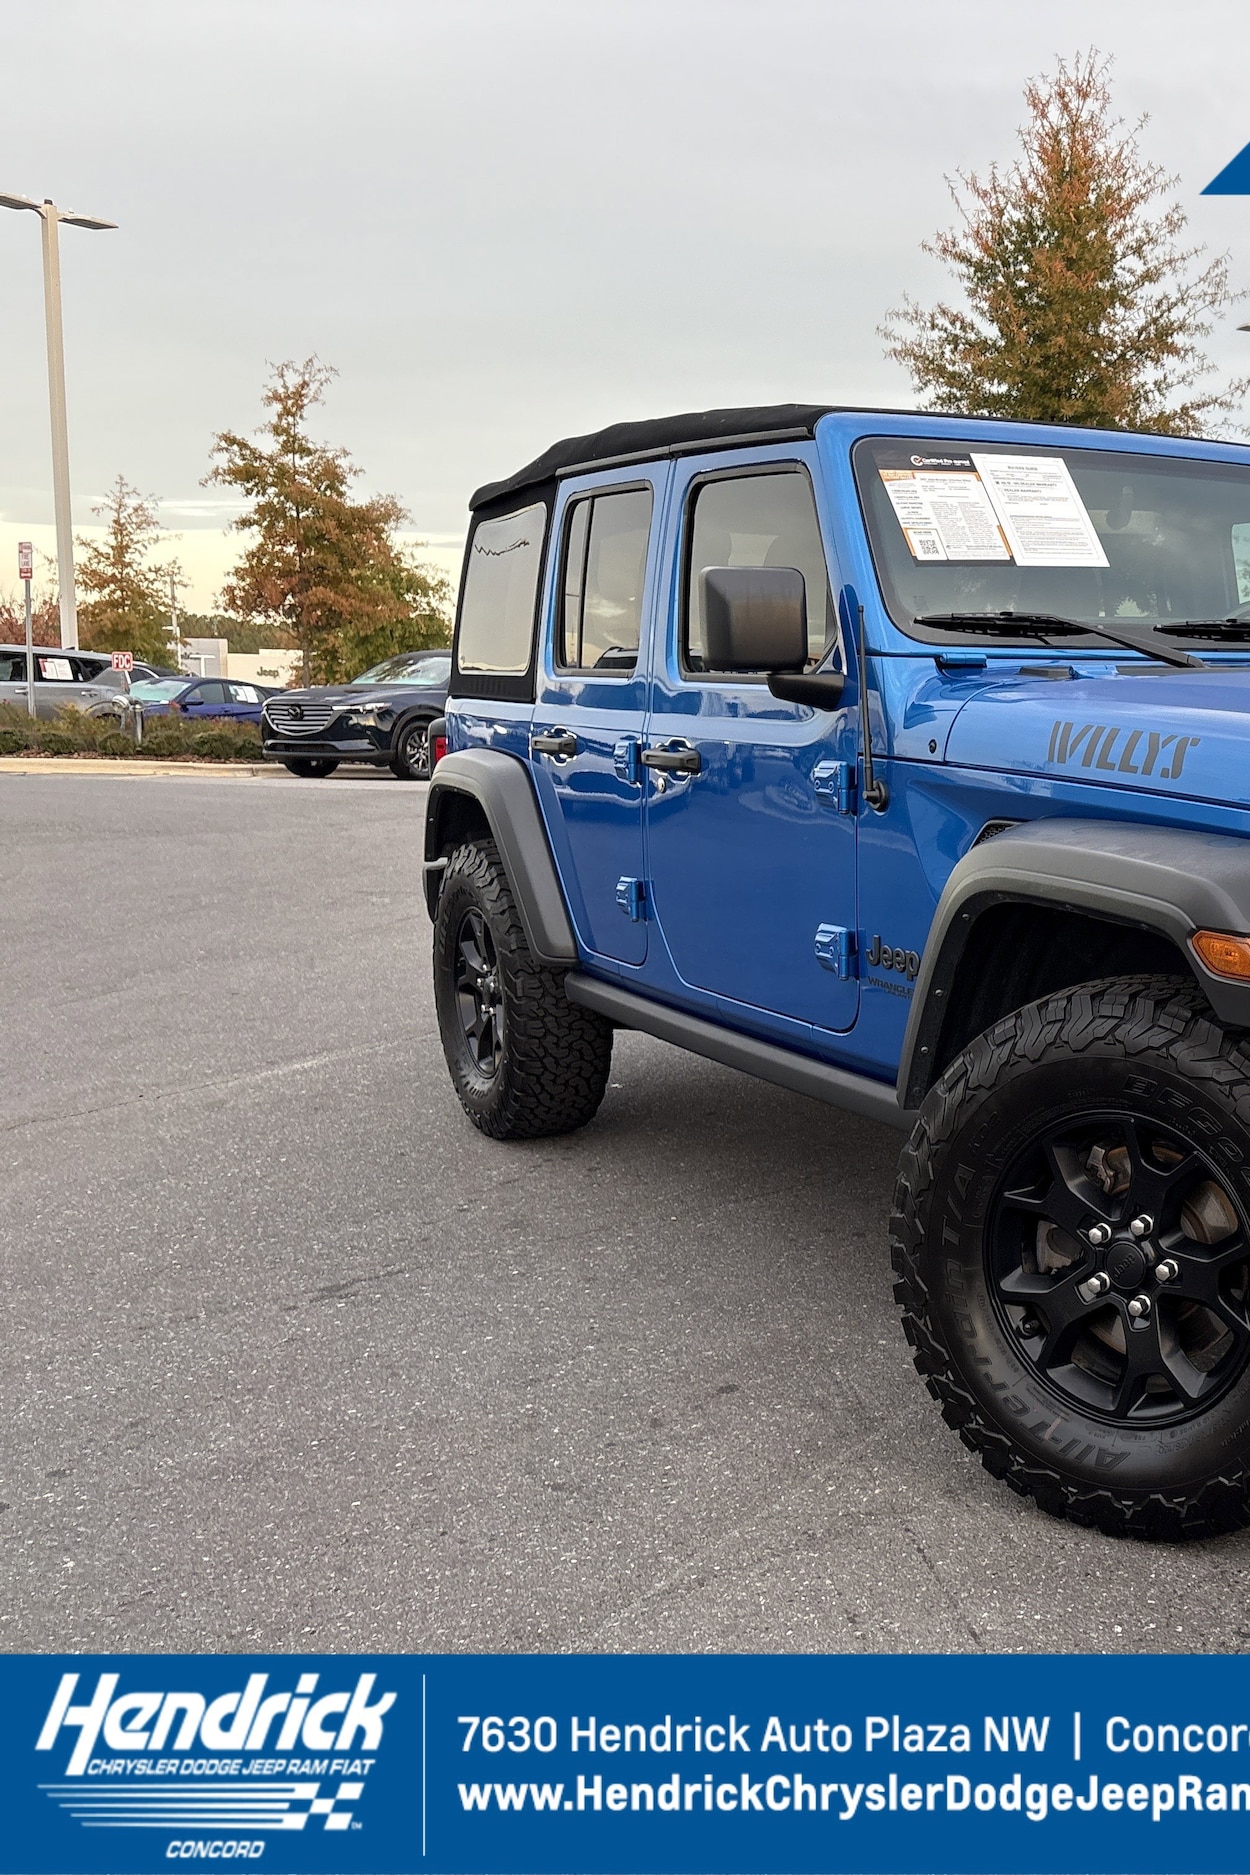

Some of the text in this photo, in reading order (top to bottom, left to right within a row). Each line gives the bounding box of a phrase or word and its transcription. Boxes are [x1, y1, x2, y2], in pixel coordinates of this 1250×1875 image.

[113, 653, 131, 669] FDC
[256, 667, 280, 678] Jeep
[1047, 720, 1201, 779] WILLYS
[865, 934, 921, 982] Jeep
[868, 976, 915, 995] WRANGLE
